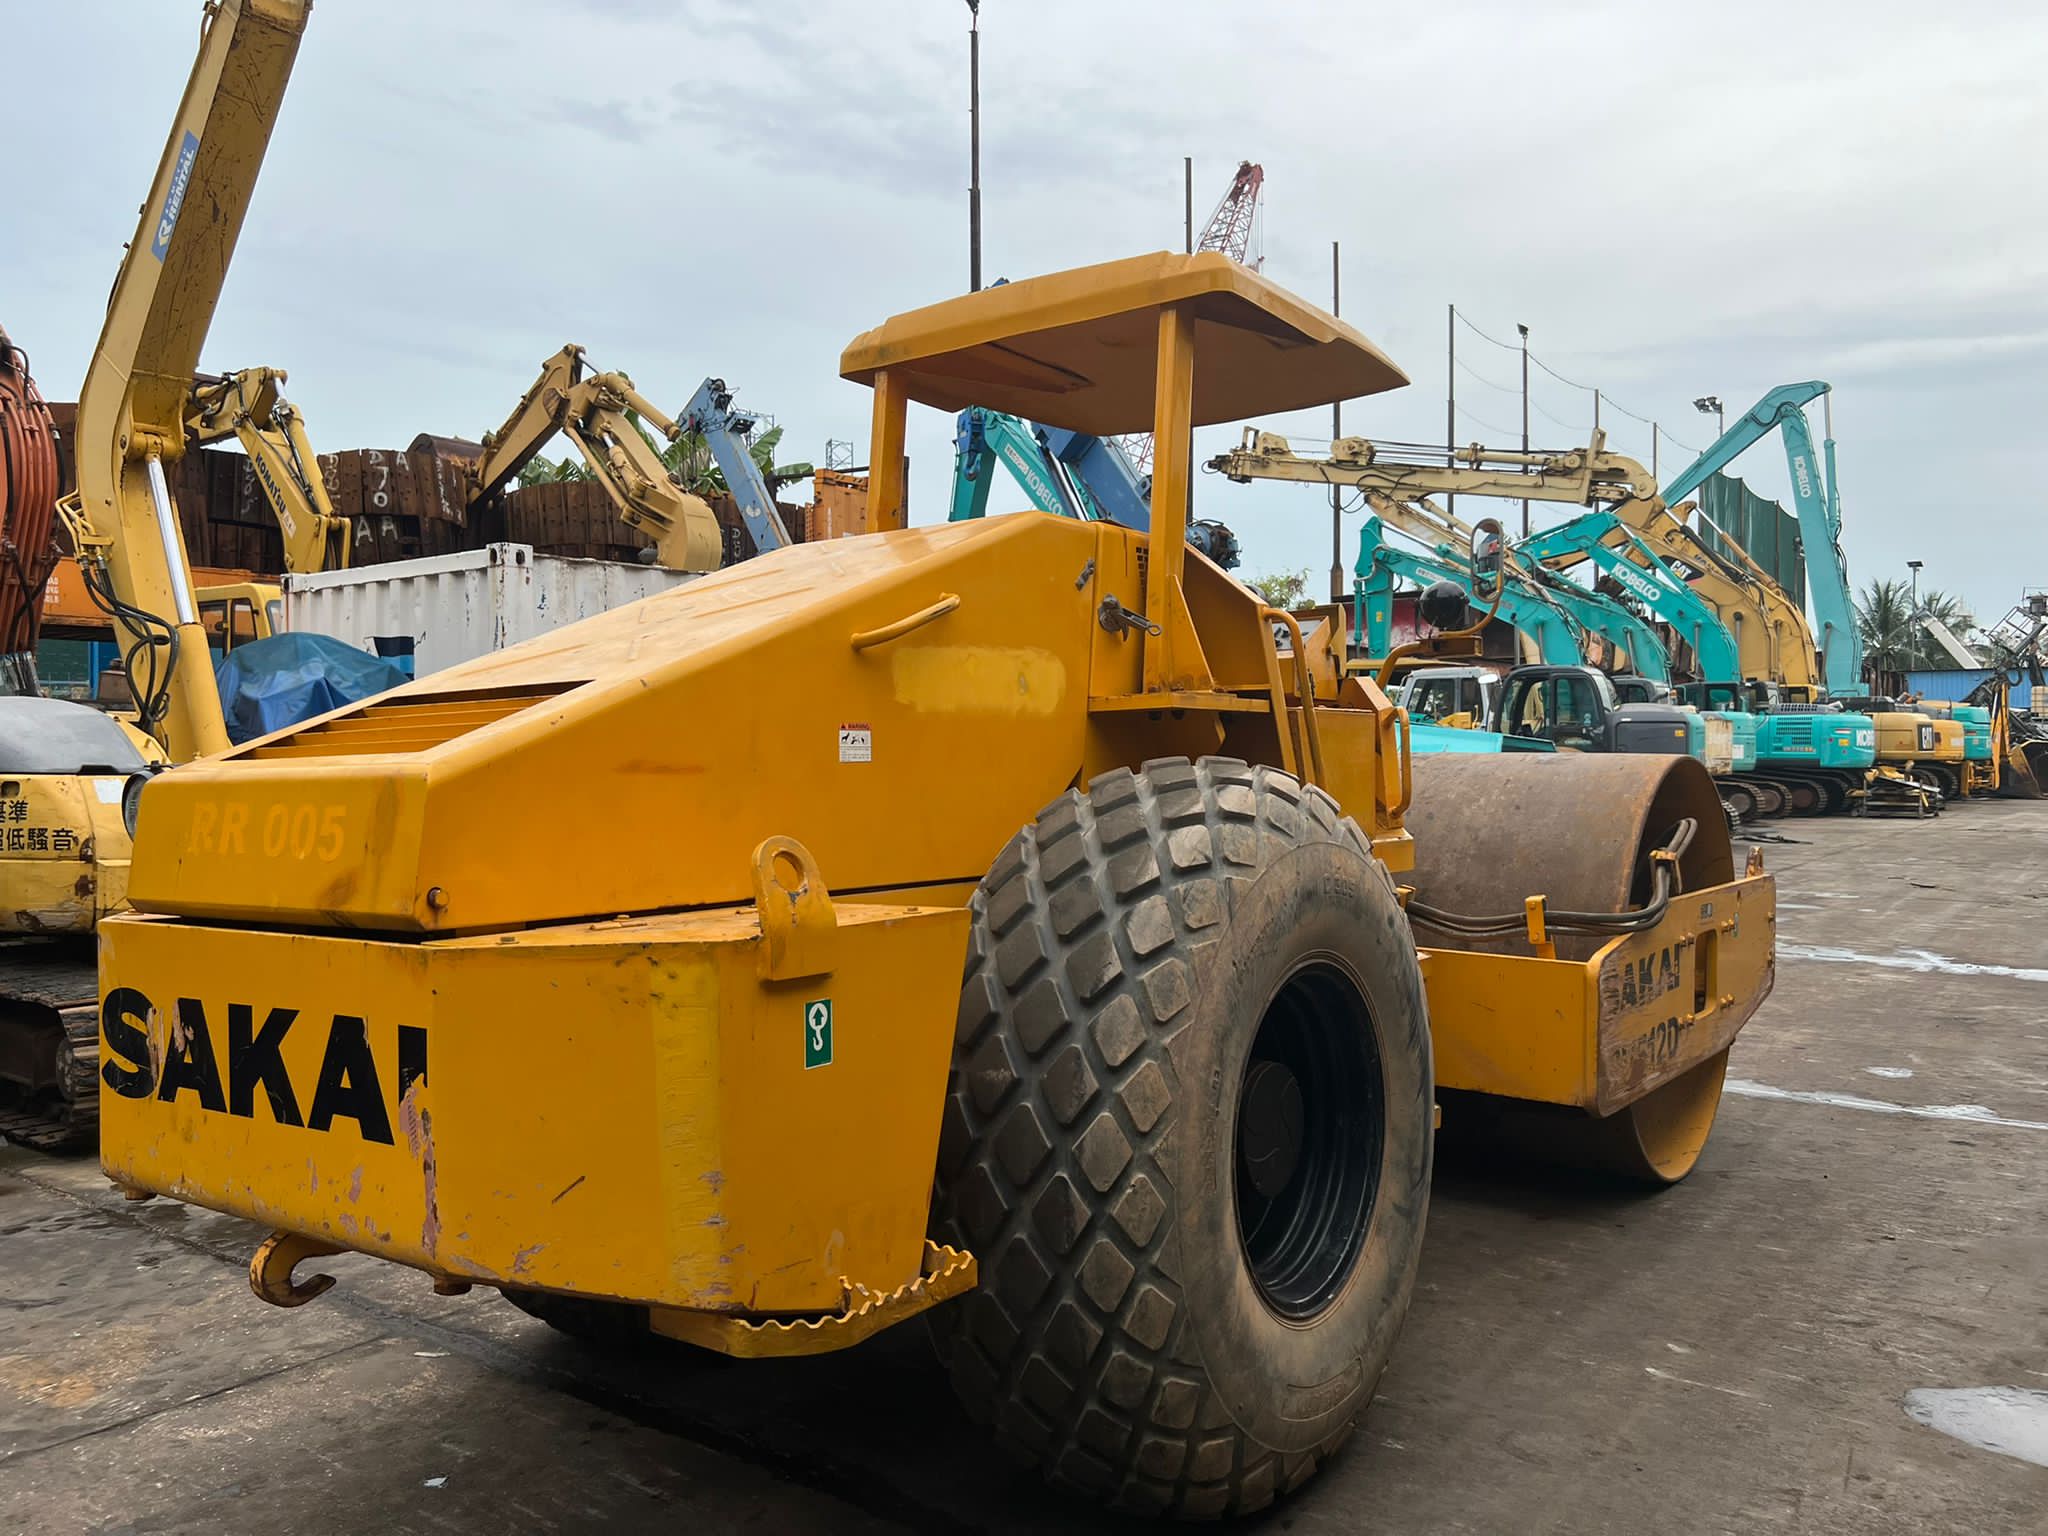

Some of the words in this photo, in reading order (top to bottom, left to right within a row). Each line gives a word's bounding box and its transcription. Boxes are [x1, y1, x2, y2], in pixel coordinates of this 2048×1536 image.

[168, 150, 194, 221] RENTAL
[256, 452, 286, 514] KOMATSU
[1025, 468, 1063, 515] KOBELCO
[1793, 455, 1811, 498] KOBELCO
[1611, 562, 1660, 601] KOBELCO
[1670, 559, 1693, 580] CAT
[0, 827, 75, 851] 低騒音
[188, 801, 250, 857] RR
[264, 802, 348, 864] 005
[101, 986, 429, 1147] SAKAI
